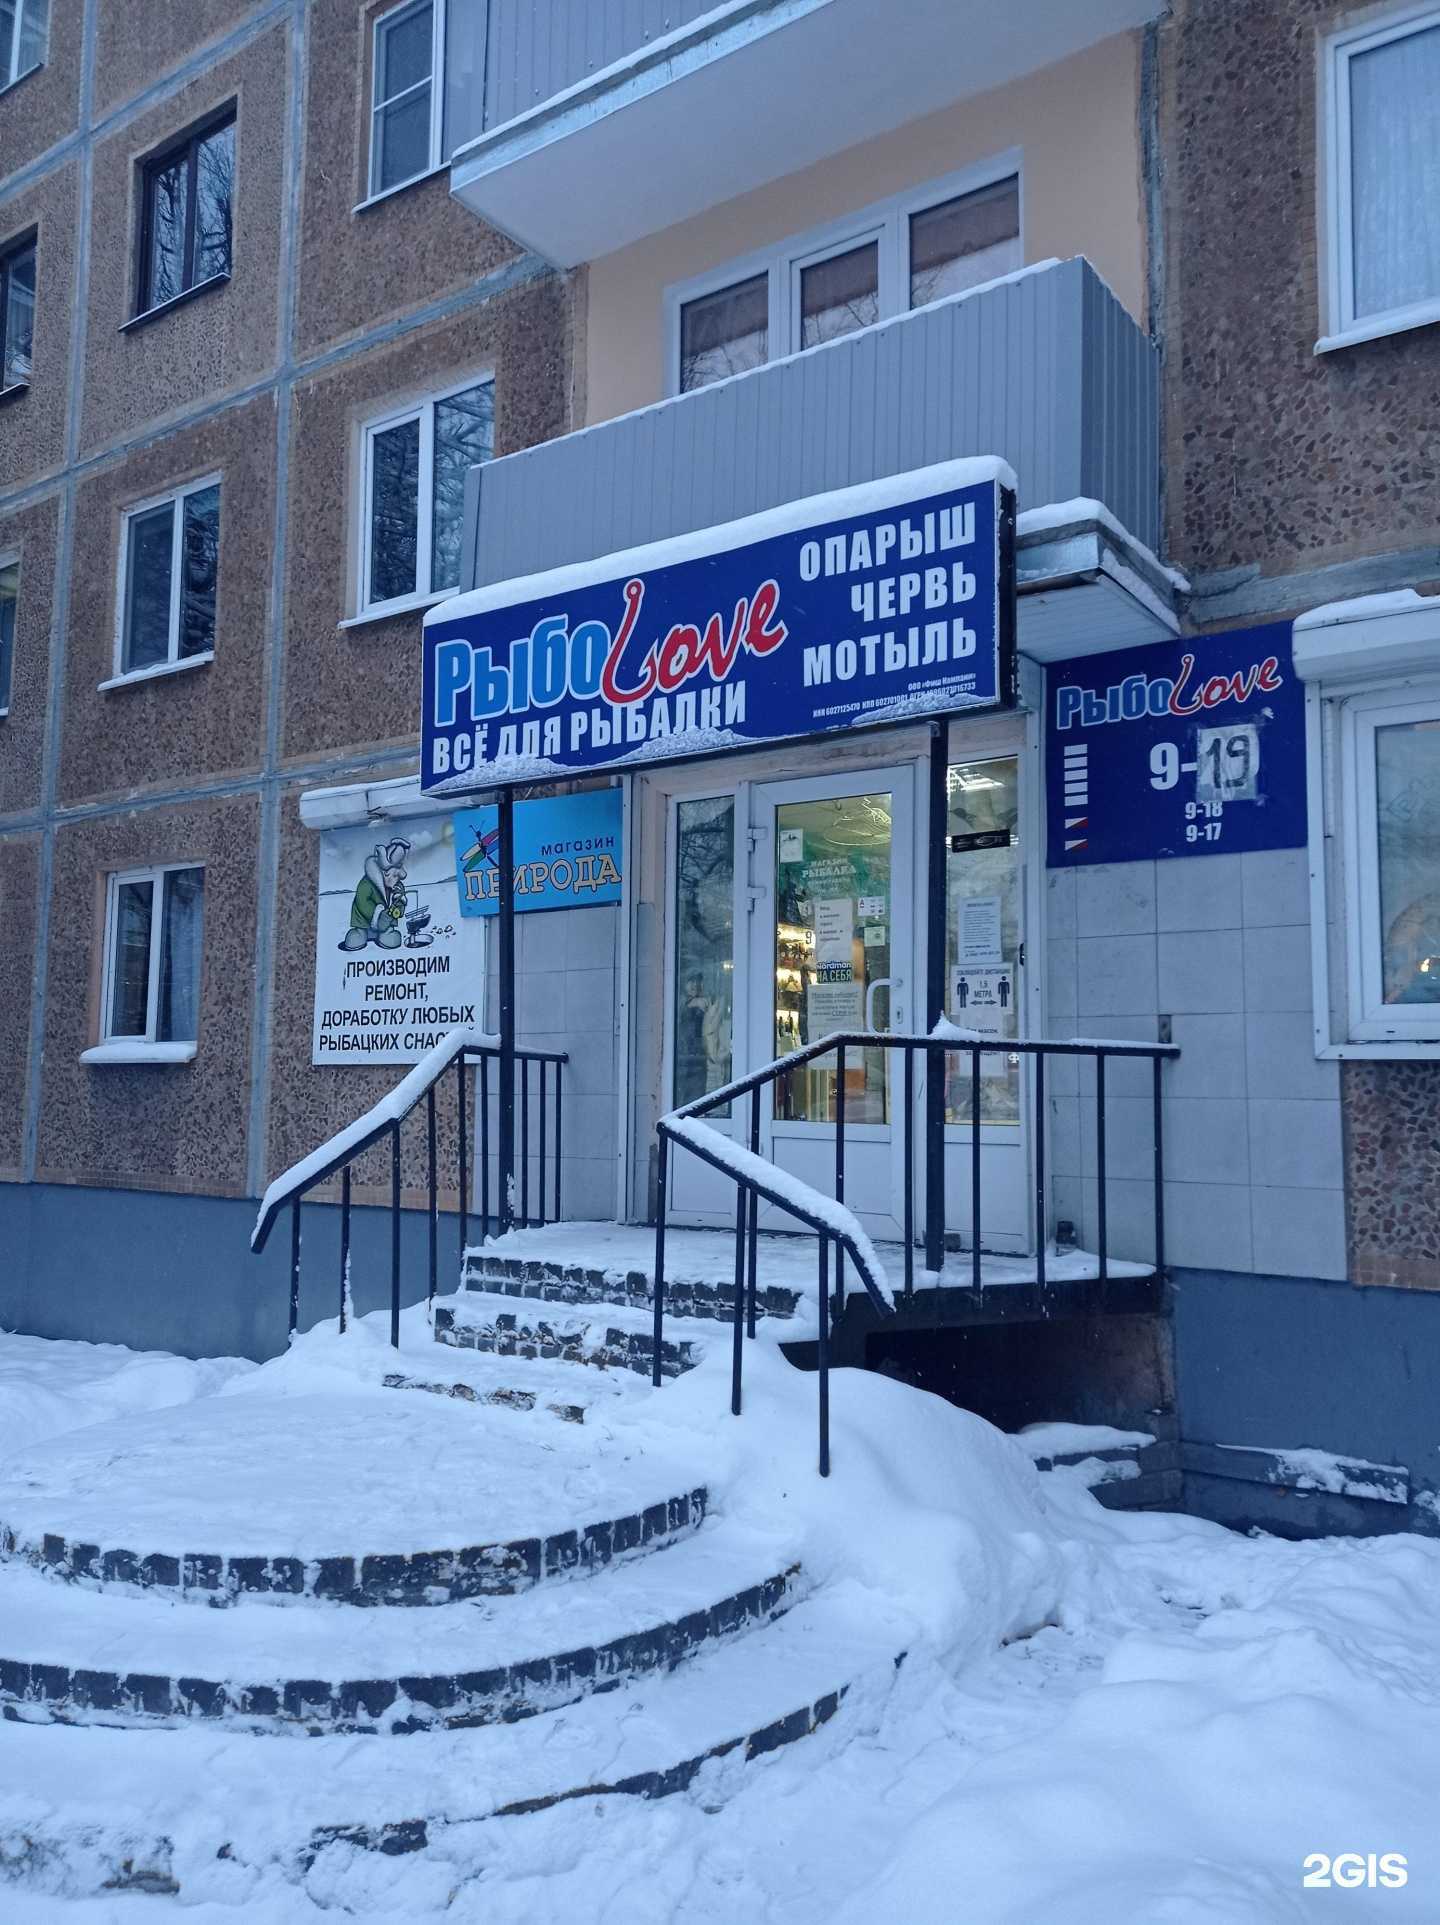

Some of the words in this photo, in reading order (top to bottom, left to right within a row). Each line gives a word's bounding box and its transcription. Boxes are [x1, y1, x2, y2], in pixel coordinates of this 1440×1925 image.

[800, 502, 976, 583] ОПАРЫШ
[851, 561, 977, 622] ЧЕРВЬ
[803, 617, 977, 687] МОТЫЛЬ
[433, 723, 489, 774] ВСЁ
[495, 716, 561, 761] ДЛЯ
[571, 680, 746, 751] РЫБАЛКИ
[1185, 801, 1223, 820] 9-18
[1186, 823, 1222, 842] 9-17
[541, 836, 615, 856] магазин
[346, 956, 450, 978] ПРОИЗВОДИМ
[365, 982, 429, 1002] РЕМОНТ,
[321, 1008, 408, 1030] ДОРАБОТКУ
[412, 1005, 475, 1025] ЛЮБЫХ
[320, 1033, 400, 1053] РЫБАЦКИХ
